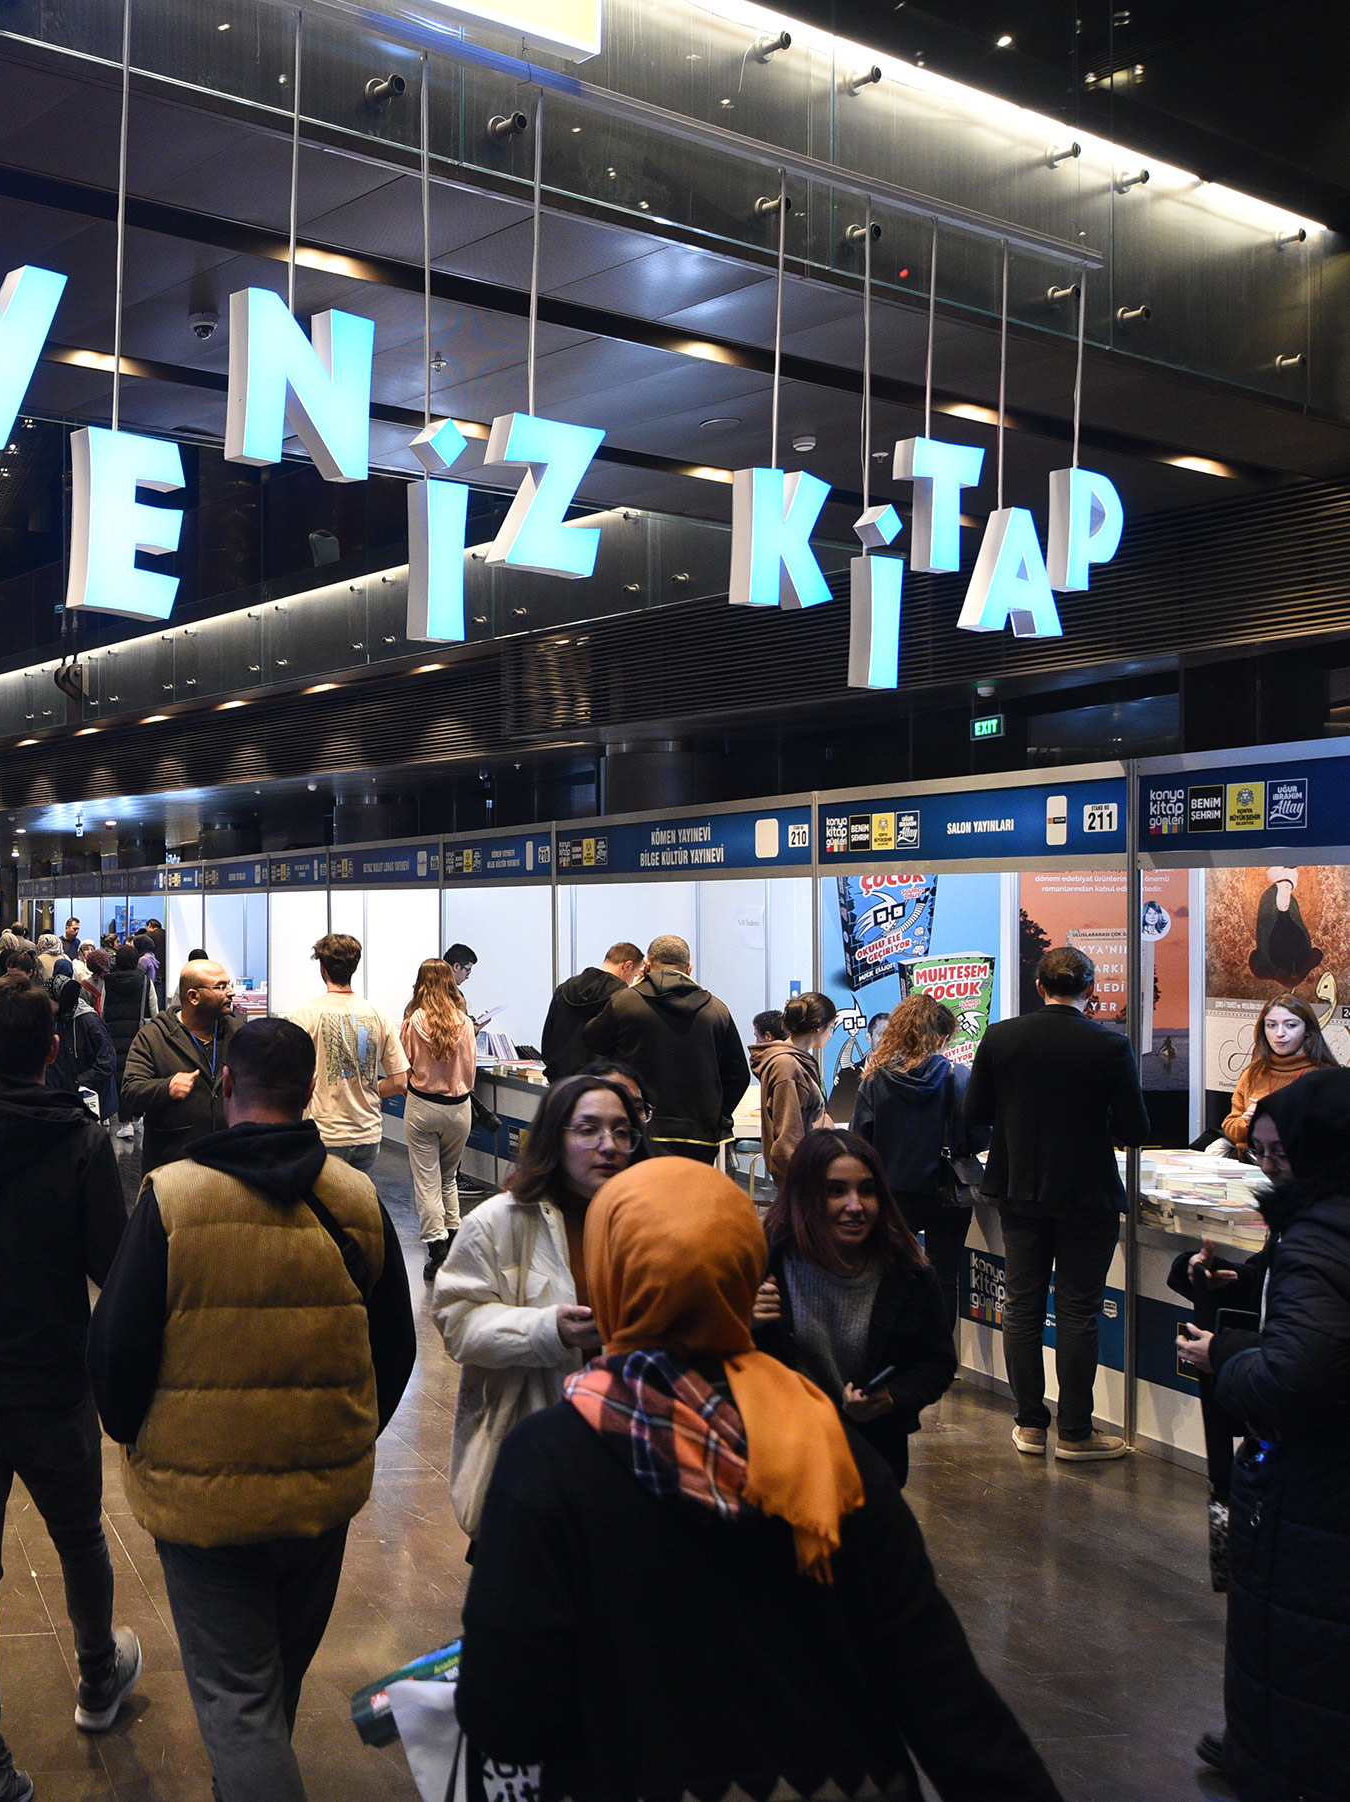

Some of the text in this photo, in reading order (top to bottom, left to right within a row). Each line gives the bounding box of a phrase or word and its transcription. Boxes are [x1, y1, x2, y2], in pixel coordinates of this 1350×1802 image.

[728, 437, 1124, 689] KİTAP
[974, 718, 998, 736] EXIT
[1149, 788, 1184, 803] konya
[1272, 791, 1303, 800] İBRAHİM
[1277, 785, 1298, 794] UĞUR
[1149, 801, 1184, 817] kitap
[1190, 797, 1221, 810] BENİM
[1269, 800, 1305, 819] Altay
[826, 816, 848, 828] konya
[1087, 811, 1113, 831] 211
[1149, 814, 1184, 829] günleri
[1190, 809, 1221, 822] ŞEHRİM
[1229, 814, 1261, 822] BÜYÜKŞEHİR
[826, 826, 848, 839] kitap
[850, 824, 870, 833] BENİM
[946, 818, 1015, 835] SALON YAYINLARI
[651, 822, 711, 846] KÖMEN YAYINEVİ
[790, 830, 807, 846] 210
[850, 833, 870, 843] ŞEHRİM
[539, 850, 549, 863] 210
[640, 843, 724, 867] BİLGE KÜLTÜR YAYINEVİ
[1061, 875, 1093, 884] edebiyat
[1041, 885, 1094, 893] romanlarından
[1094, 885, 1115, 893] kabul
[856, 933, 901, 960] OKULU ELE
[915, 965, 988, 985] MUHTEŞEM
[1094, 964, 1124, 973] ARKI
[858, 970, 874, 982] MICK
[1096, 980, 1125, 993] LEDİ
[1090, 1001, 1117, 1012] YER
[961, 1043, 972, 1053] ELE
[969, 1251, 1005, 1283] konya
[969, 1268, 1006, 1302] kitap
